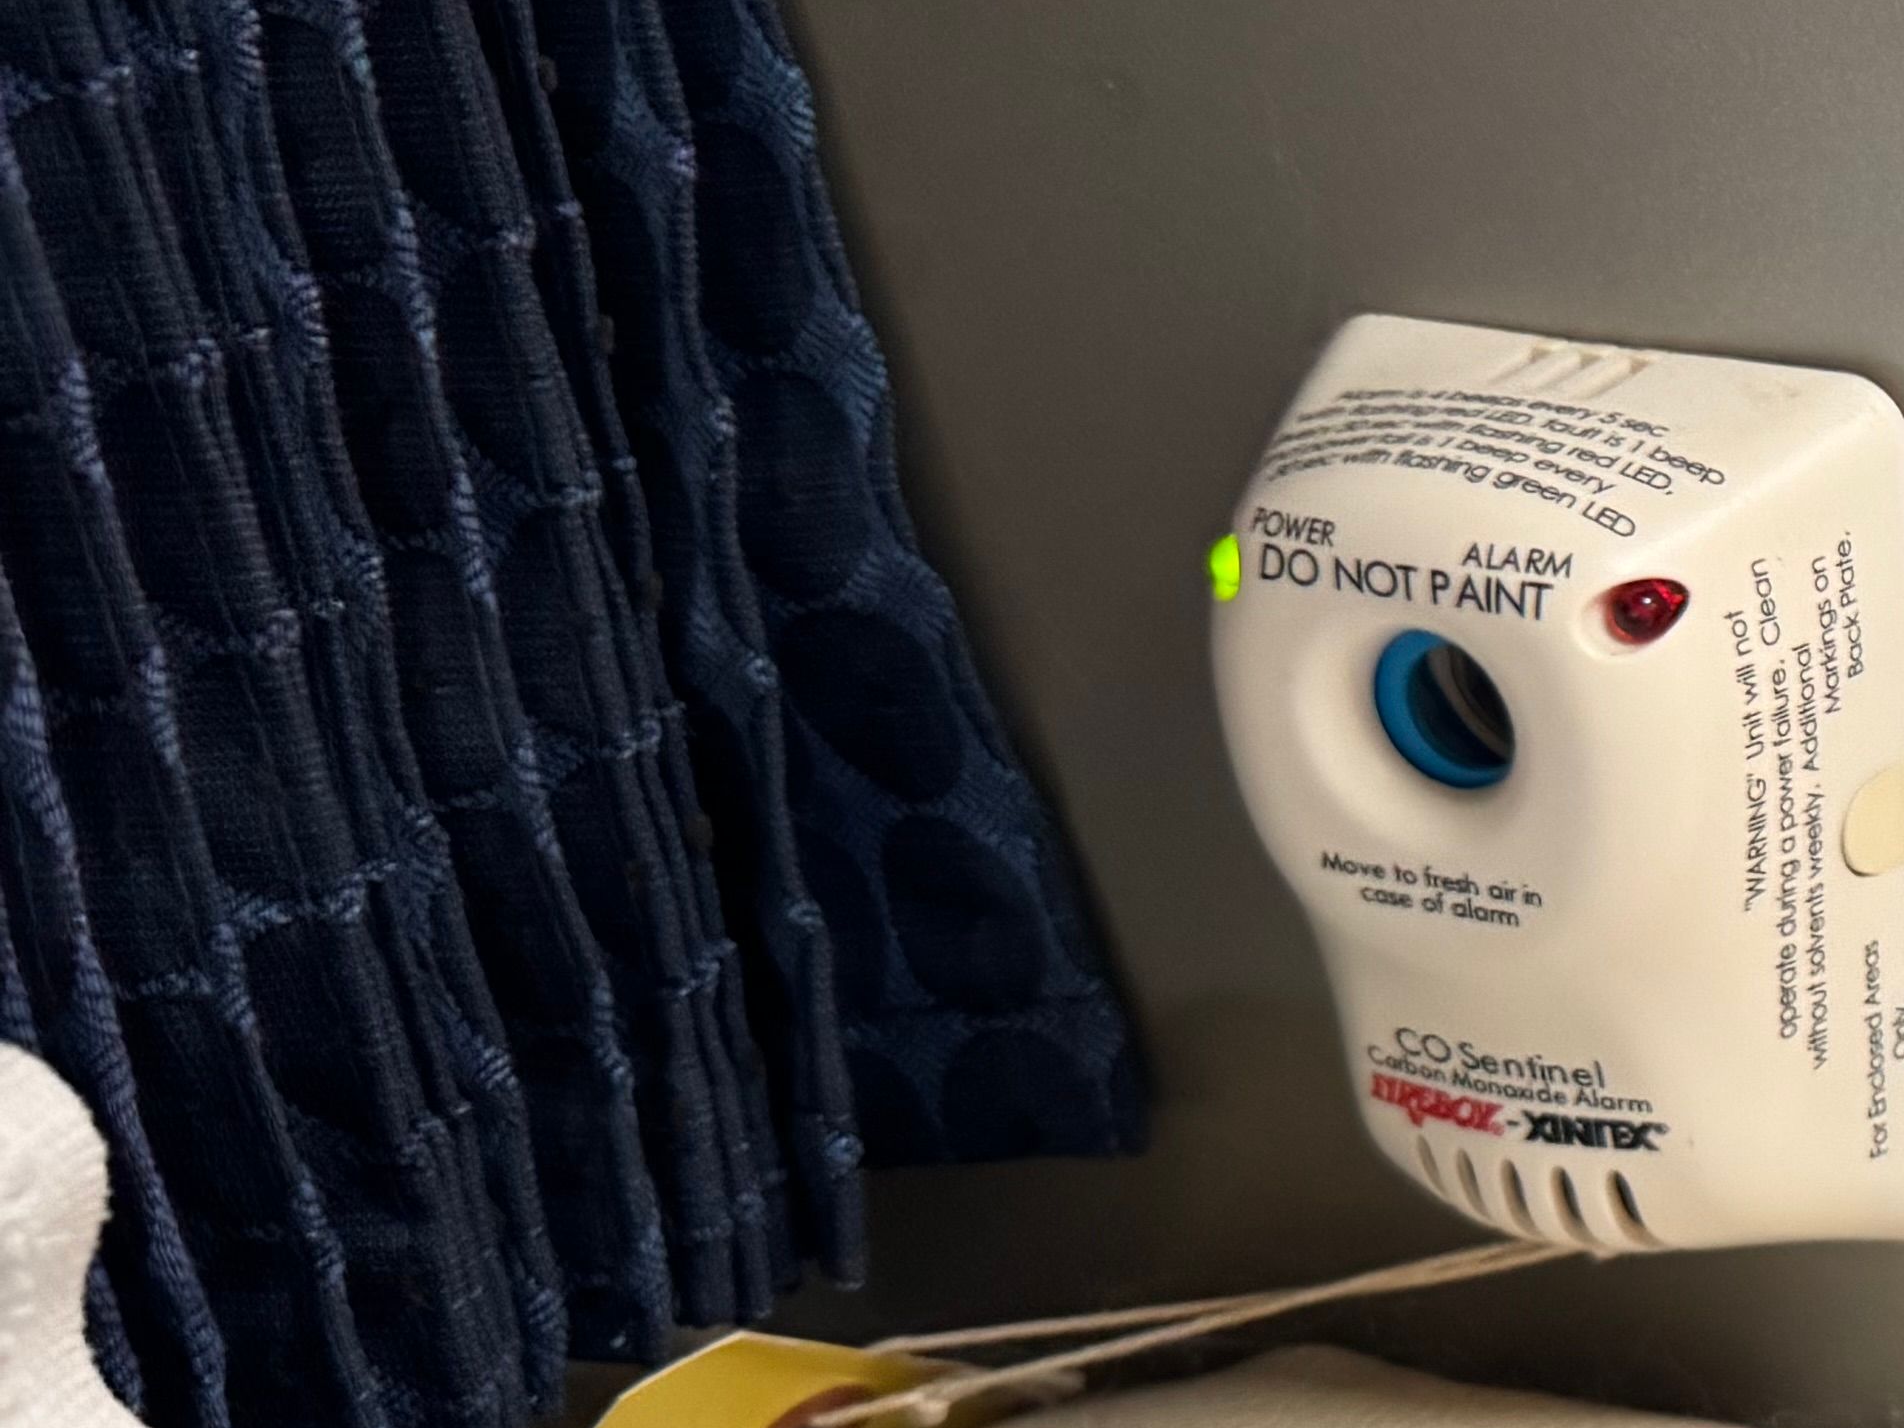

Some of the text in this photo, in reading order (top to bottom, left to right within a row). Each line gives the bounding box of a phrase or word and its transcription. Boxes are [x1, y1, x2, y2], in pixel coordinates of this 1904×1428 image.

[1540, 418, 1602, 440] fault
[1602, 430, 1627, 448] is
[1630, 439, 1645, 453] 1
[1648, 445, 1726, 485] beep
[1600, 411, 1623, 424] 5
[1620, 418, 1670, 438] sec
[1456, 439, 1530, 464] beep
[1533, 458, 1617, 495] every
[1567, 445, 1622, 469] red
[1620, 460, 1674, 495] LED,
[1252, 507, 1336, 548] POWER
[1493, 470, 1577, 509] green
[1582, 500, 1637, 538] LED
[1260, 543, 1554, 621] DO NOT PAINT
[1462, 542, 1573, 579] ALARM
[1724, 610, 1752, 656] not
[1811, 555, 1843, 715] Markings on
[1836, 530, 1864, 679] Back Plate.
[1736, 663, 1758, 705] will
[1742, 711, 1765, 760] Unit
[1751, 557, 1802, 1040] operate during a power failure. Clean
[1321, 850, 1543, 908] Move to fresh air in
[1791, 642, 1829, 1070] without solvents weekly. Additional
[1360, 886, 1521, 929] case of alarm
[1366, 1044, 1654, 1115] Carbon Monoxide Alarm
[1394, 1026, 1606, 1090] CO Sentinel
[1863, 939, 1889, 1160] For Enclosed Areas
